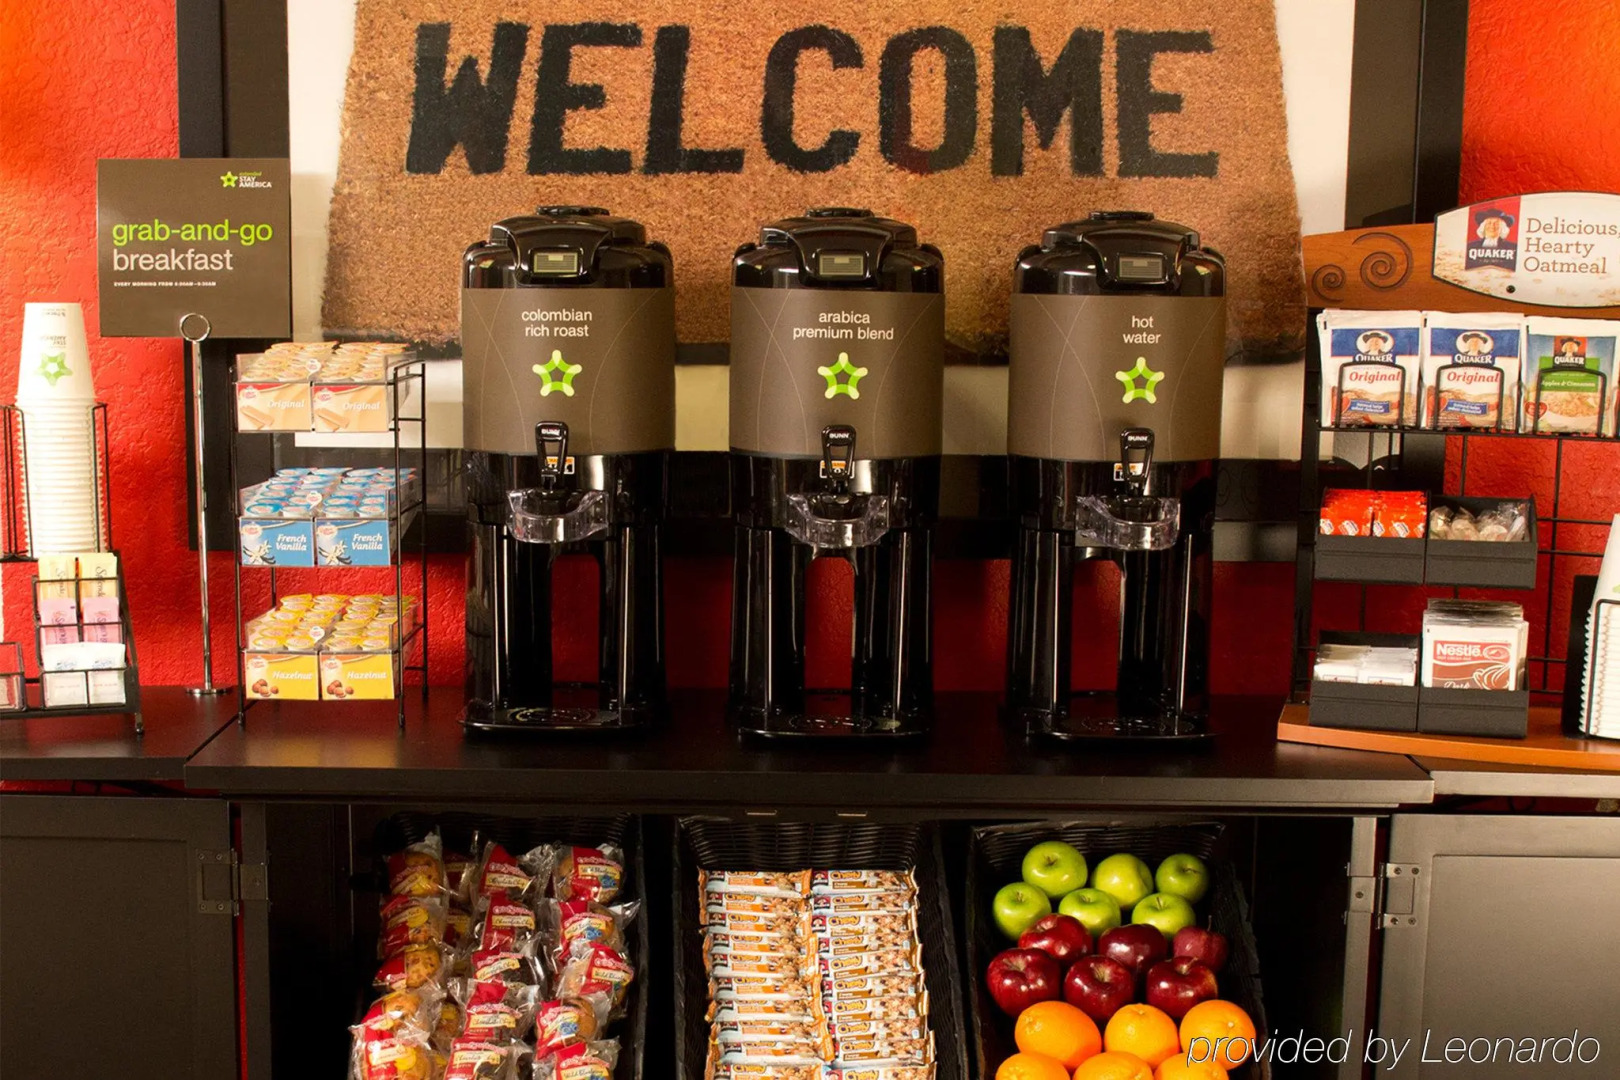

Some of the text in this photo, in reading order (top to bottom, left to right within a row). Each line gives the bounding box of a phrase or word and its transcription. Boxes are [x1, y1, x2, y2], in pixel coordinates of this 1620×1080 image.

[404, 23, 1220, 179] WELCOME
[112, 219, 273, 247] grab-and-go
[1526, 216, 1620, 239] Delicious,
[1524, 237, 1595, 258] Hearty
[113, 248, 234, 271] breakfast
[1468, 248, 1515, 261] QUAKER
[1524, 256, 1607, 274] Oatmeal
[521, 308, 593, 321] colombian
[818, 310, 871, 324] arabica
[1131, 315, 1154, 328] hot
[525, 324, 590, 337] rich roast
[793, 326, 894, 340] premium blend
[1122, 331, 1161, 344] water
[1355, 353, 1393, 362] QUAKER
[1454, 353, 1492, 363] QUAKER
[1554, 356, 1585, 364] QUAKER
[1349, 371, 1401, 384] Original
[1447, 371, 1499, 385] Original
[267, 400, 304, 410] Original
[342, 401, 380, 411] Original
[277, 534, 307, 543] French
[352, 533, 383, 542] French
[275, 542, 307, 551] Vanilla
[351, 542, 383, 551] Vanilla
[272, 671, 313, 680] Hazelnut
[347, 671, 387, 680] Hazelnut
